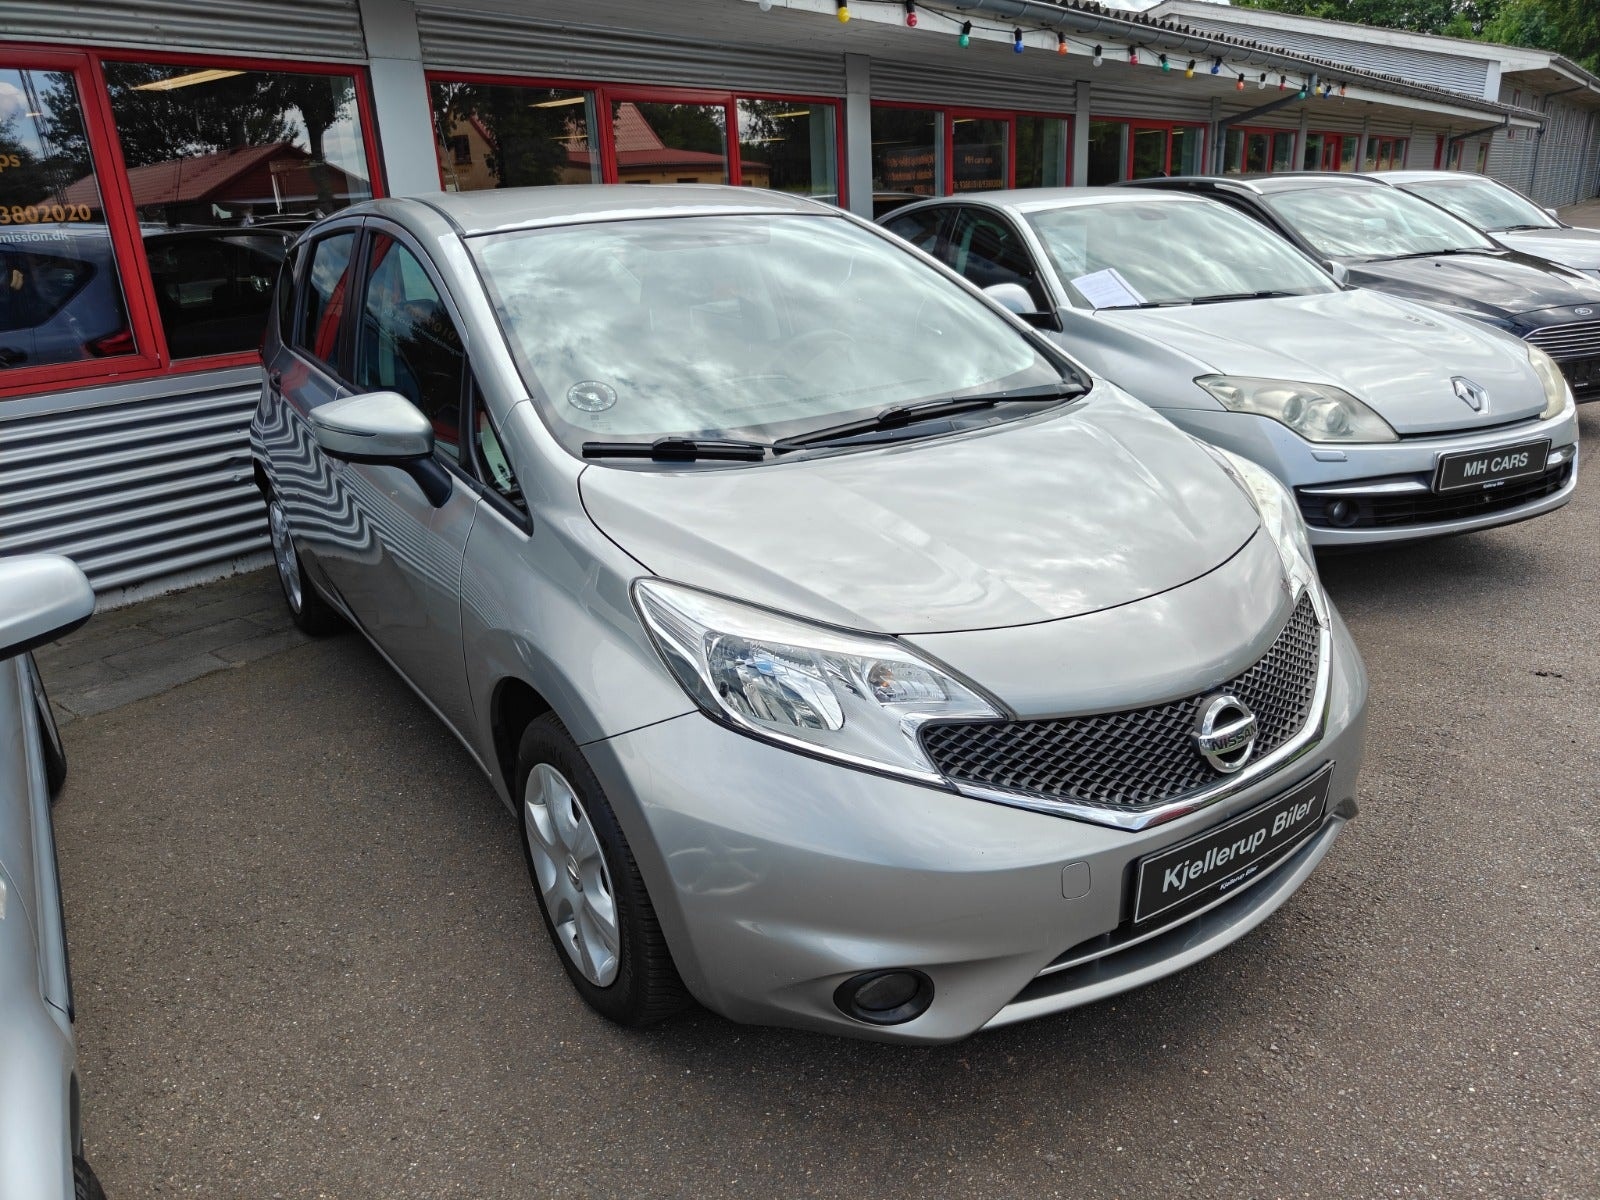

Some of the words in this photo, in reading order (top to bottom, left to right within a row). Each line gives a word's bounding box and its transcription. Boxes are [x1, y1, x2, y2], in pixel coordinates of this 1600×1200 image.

[1463, 459, 1488, 477] MH
[1491, 452, 1528, 472] CARS
[1211, 724, 1257, 751] NISSAN
[1162, 828, 1266, 893] Kjellerup
[1271, 796, 1316, 838] Biler
